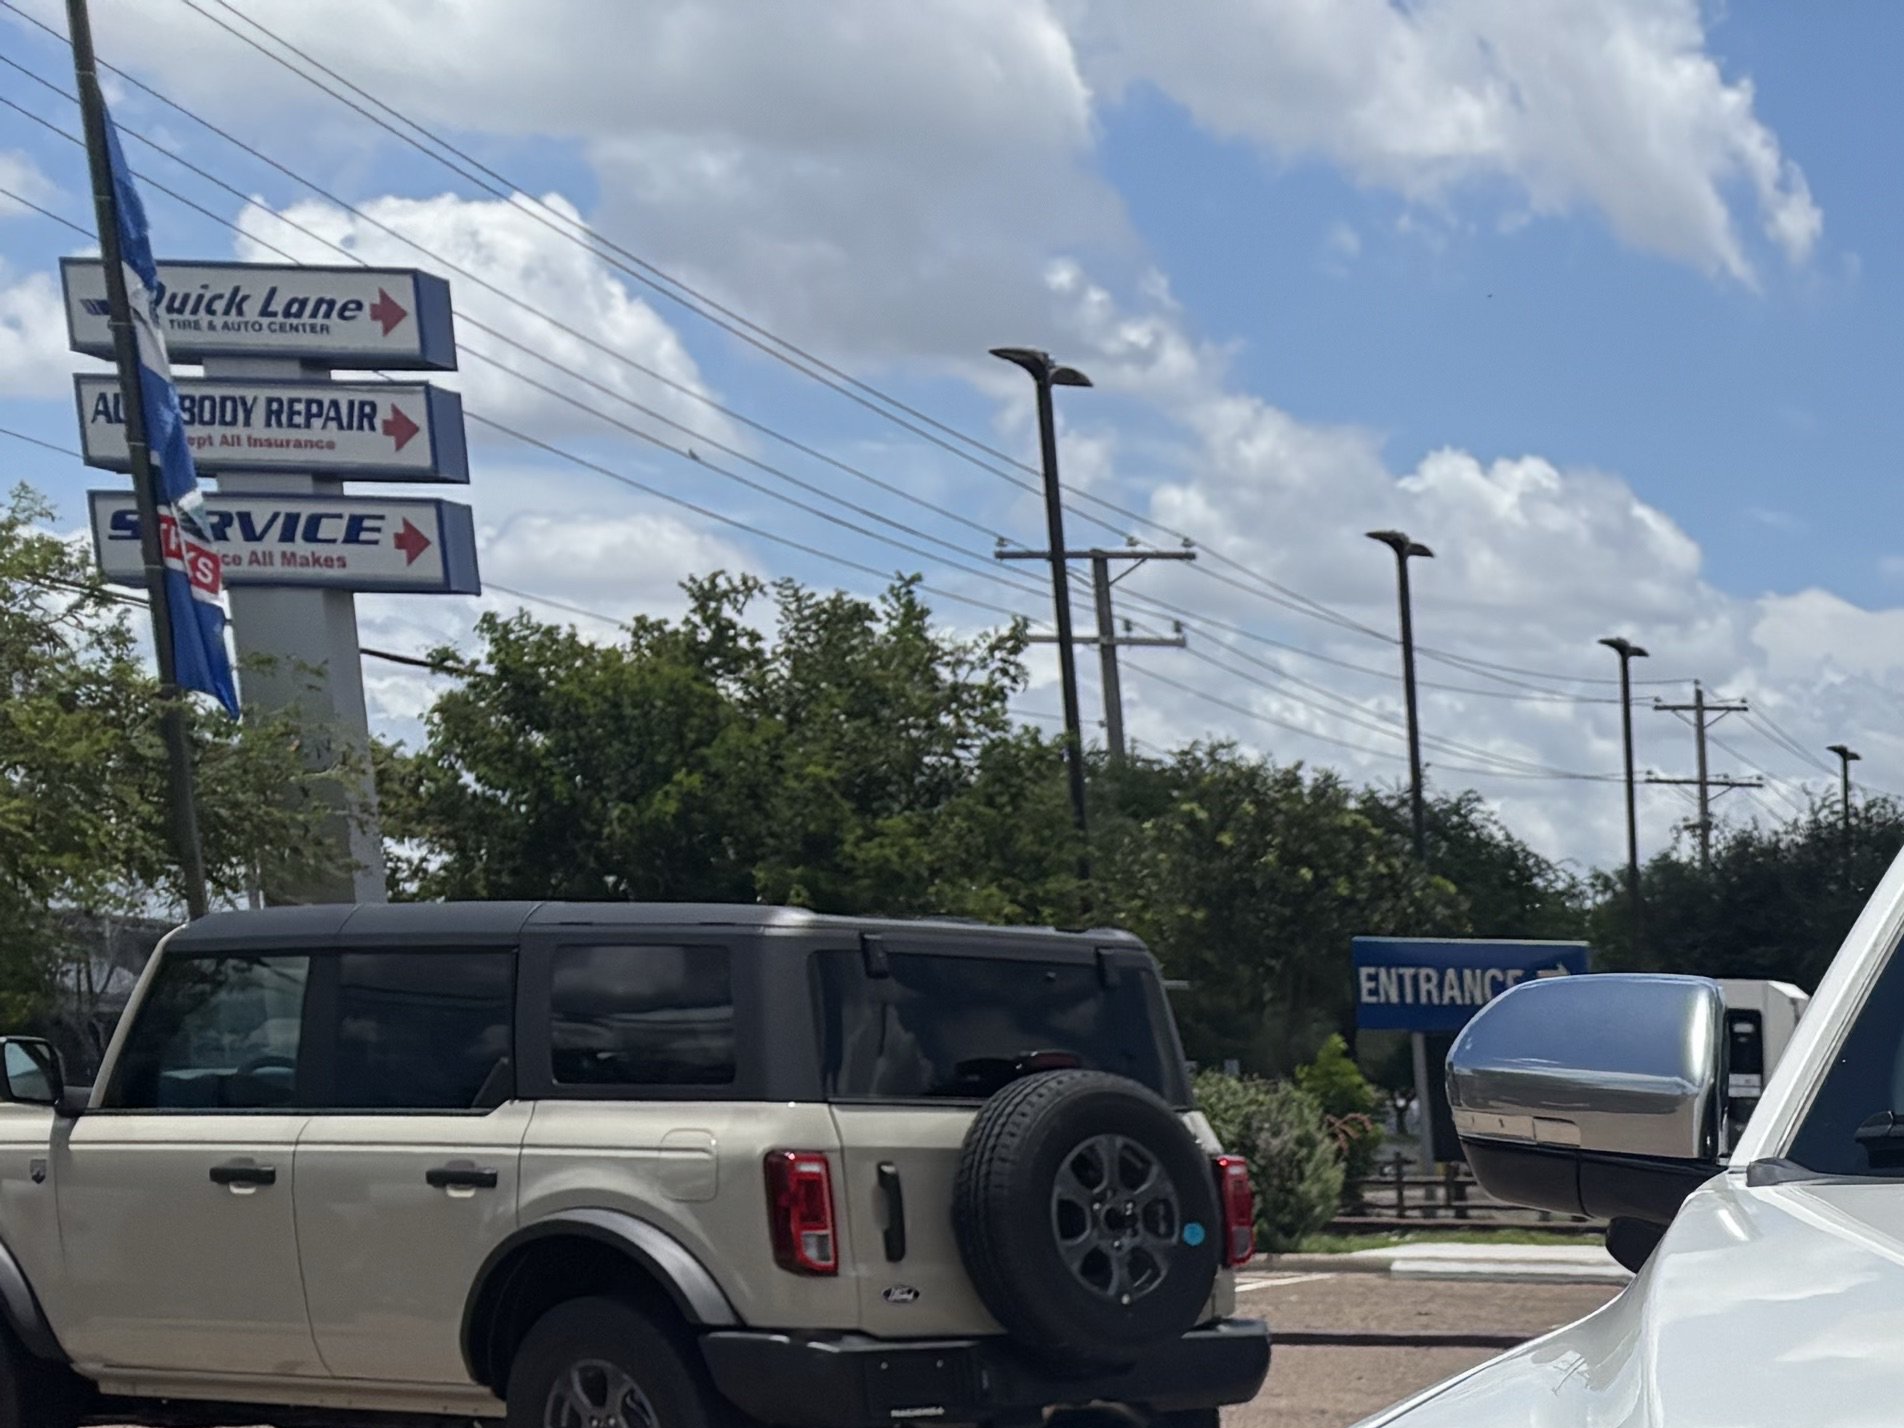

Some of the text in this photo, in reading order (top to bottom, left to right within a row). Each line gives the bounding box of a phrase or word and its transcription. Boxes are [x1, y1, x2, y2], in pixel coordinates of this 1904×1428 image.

[258, 286, 365, 322] Lane
[169, 318, 330, 336] TIRE & AUTO CENTER
[264, 396, 378, 433] REPAIR
[219, 433, 242, 448] All
[247, 434, 336, 451] Insurance
[108, 508, 386, 546] SRVICE
[250, 551, 274, 567] All
[281, 551, 347, 569] Makes
